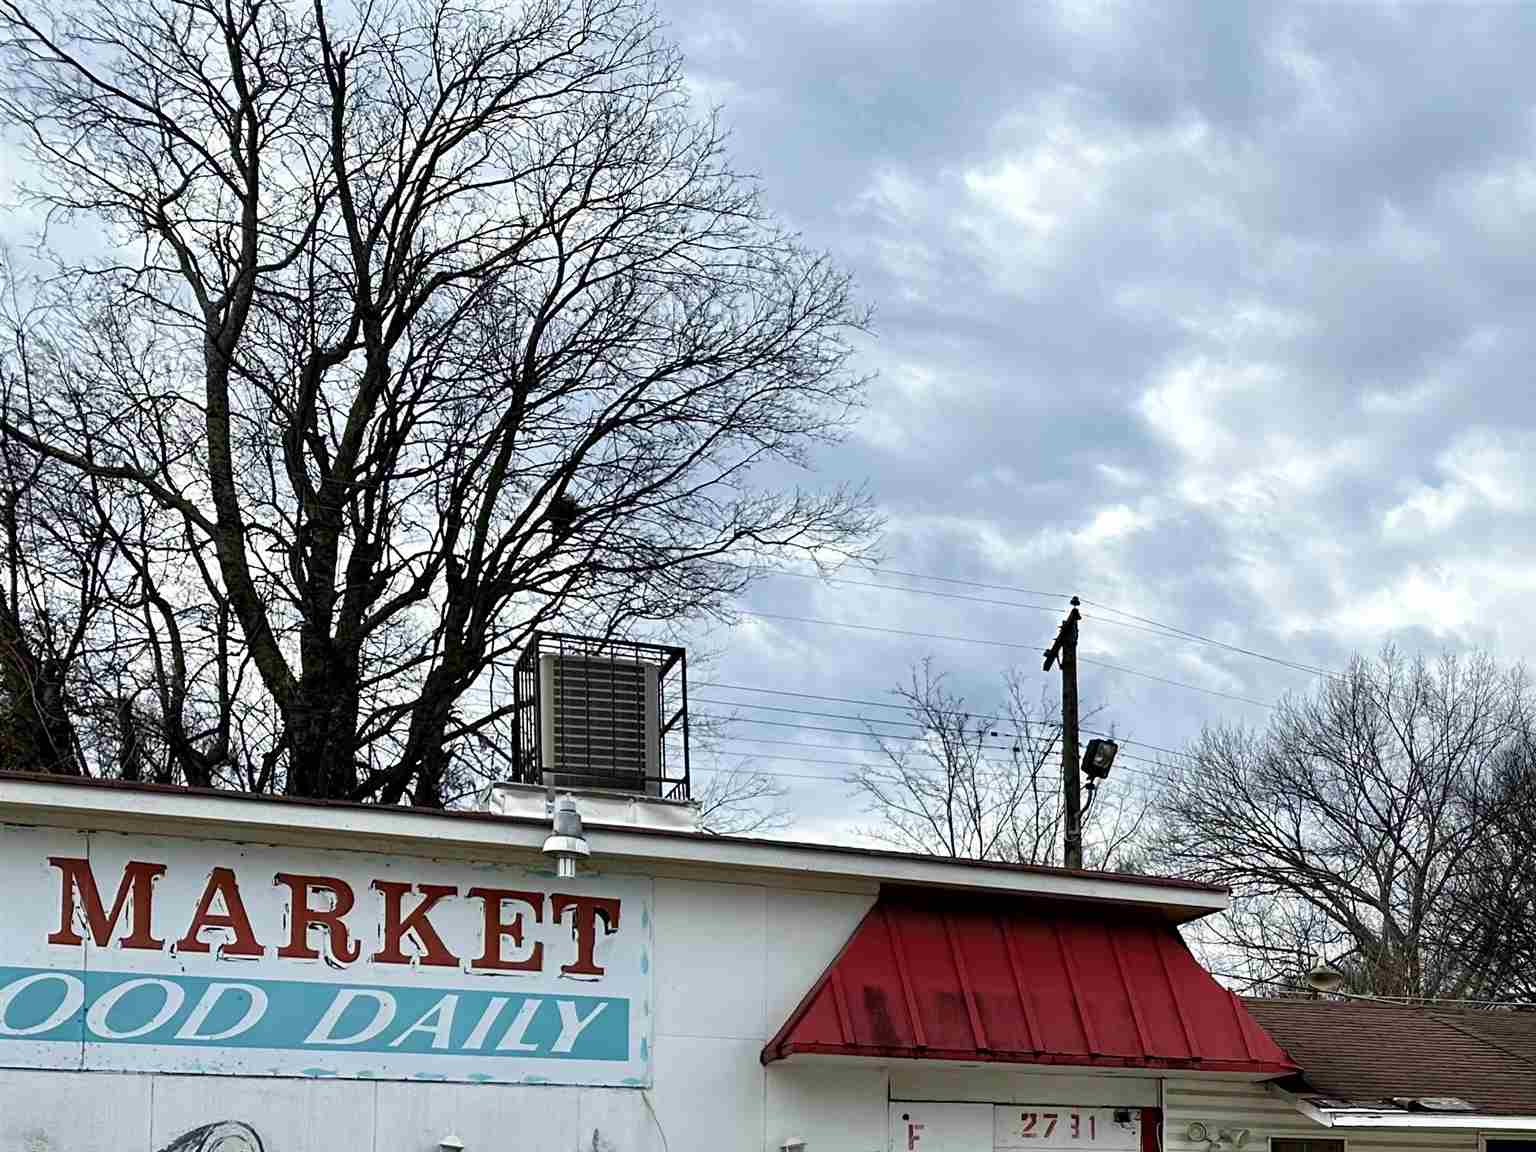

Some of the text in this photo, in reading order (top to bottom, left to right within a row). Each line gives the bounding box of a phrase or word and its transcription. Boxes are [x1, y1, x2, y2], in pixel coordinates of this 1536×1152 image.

[48, 857, 621, 977] MARKET
[0, 972, 609, 1053] OOD DAILY
[1020, 1112, 1096, 1140] 2731
